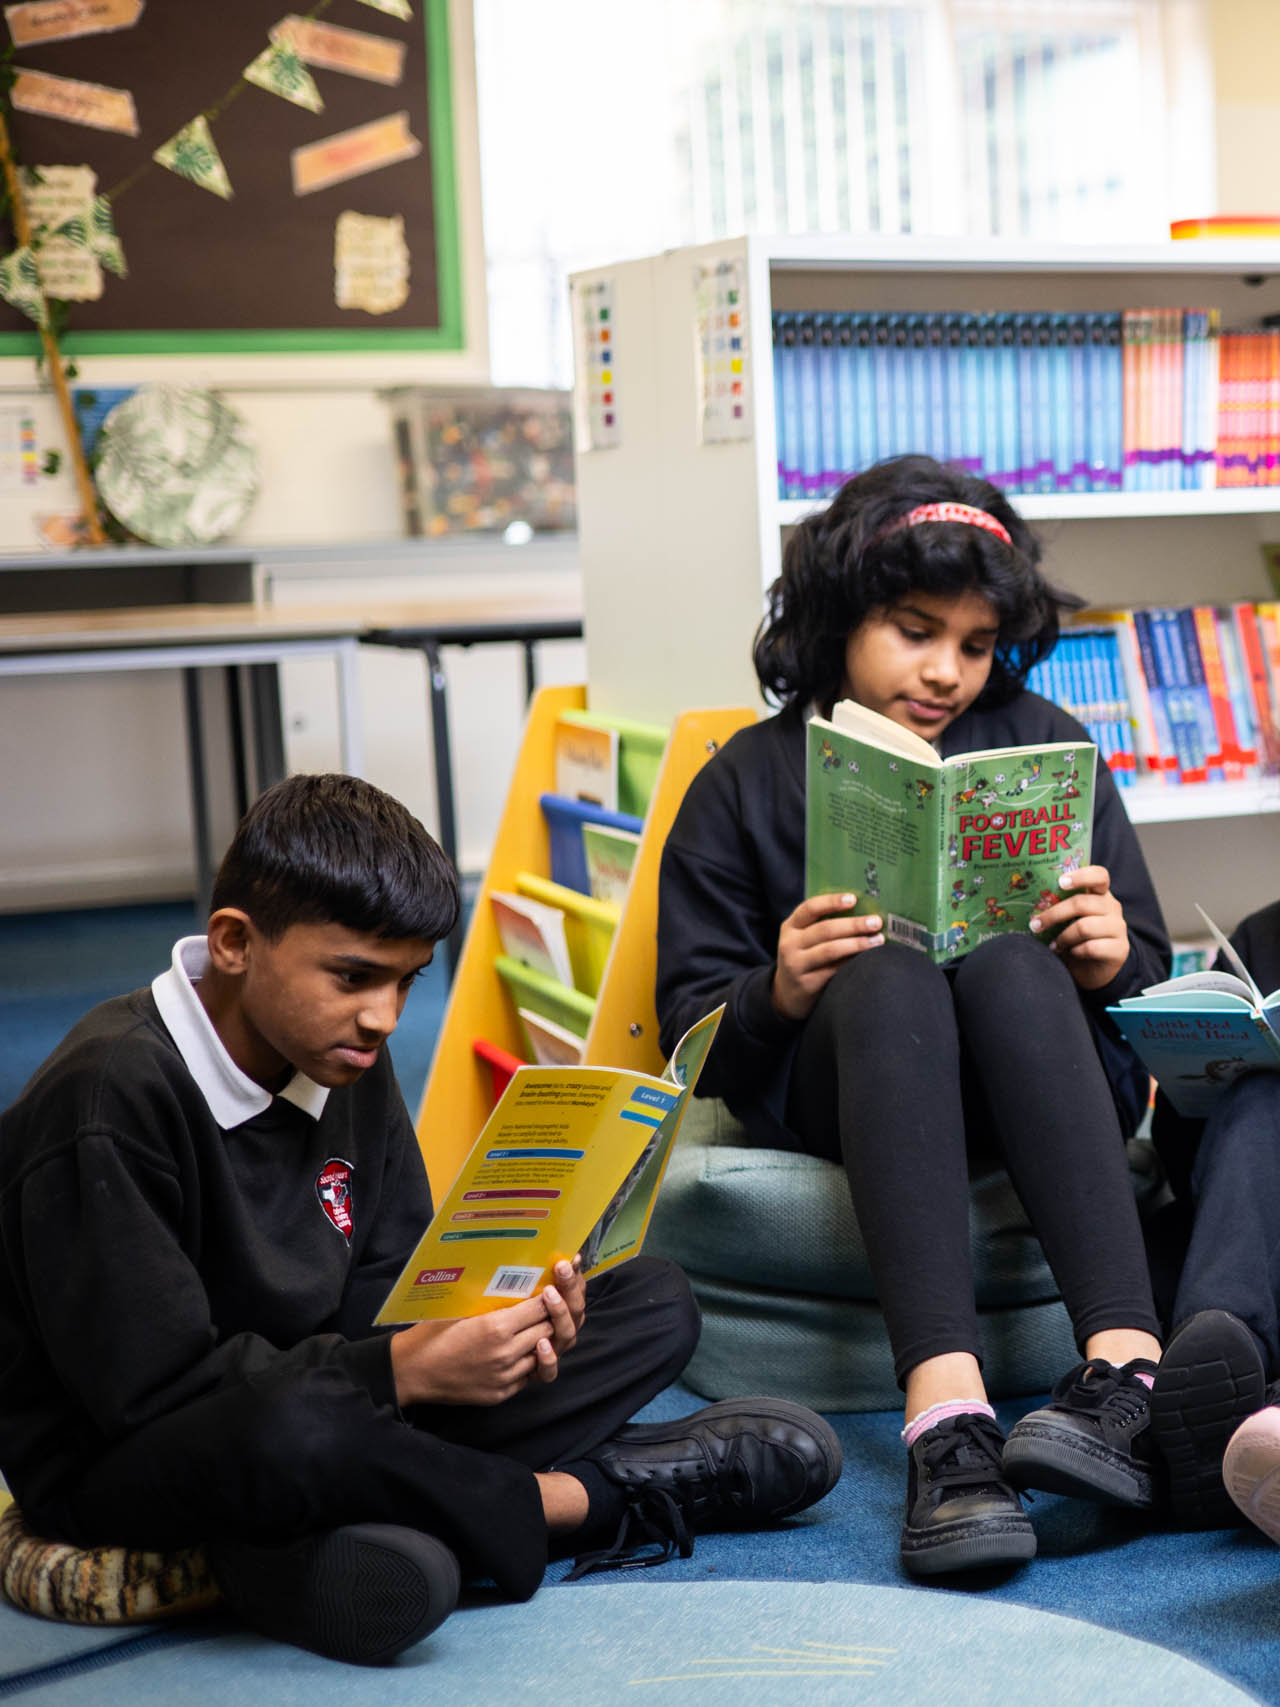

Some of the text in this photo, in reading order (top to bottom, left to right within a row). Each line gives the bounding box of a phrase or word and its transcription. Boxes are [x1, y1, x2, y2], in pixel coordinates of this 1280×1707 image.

[959, 803, 1076, 833] FOOTBALL
[961, 824, 1074, 862] FEVER
[640, 1091, 661, 1103] Level
[420, 1270, 458, 1283] Collins
